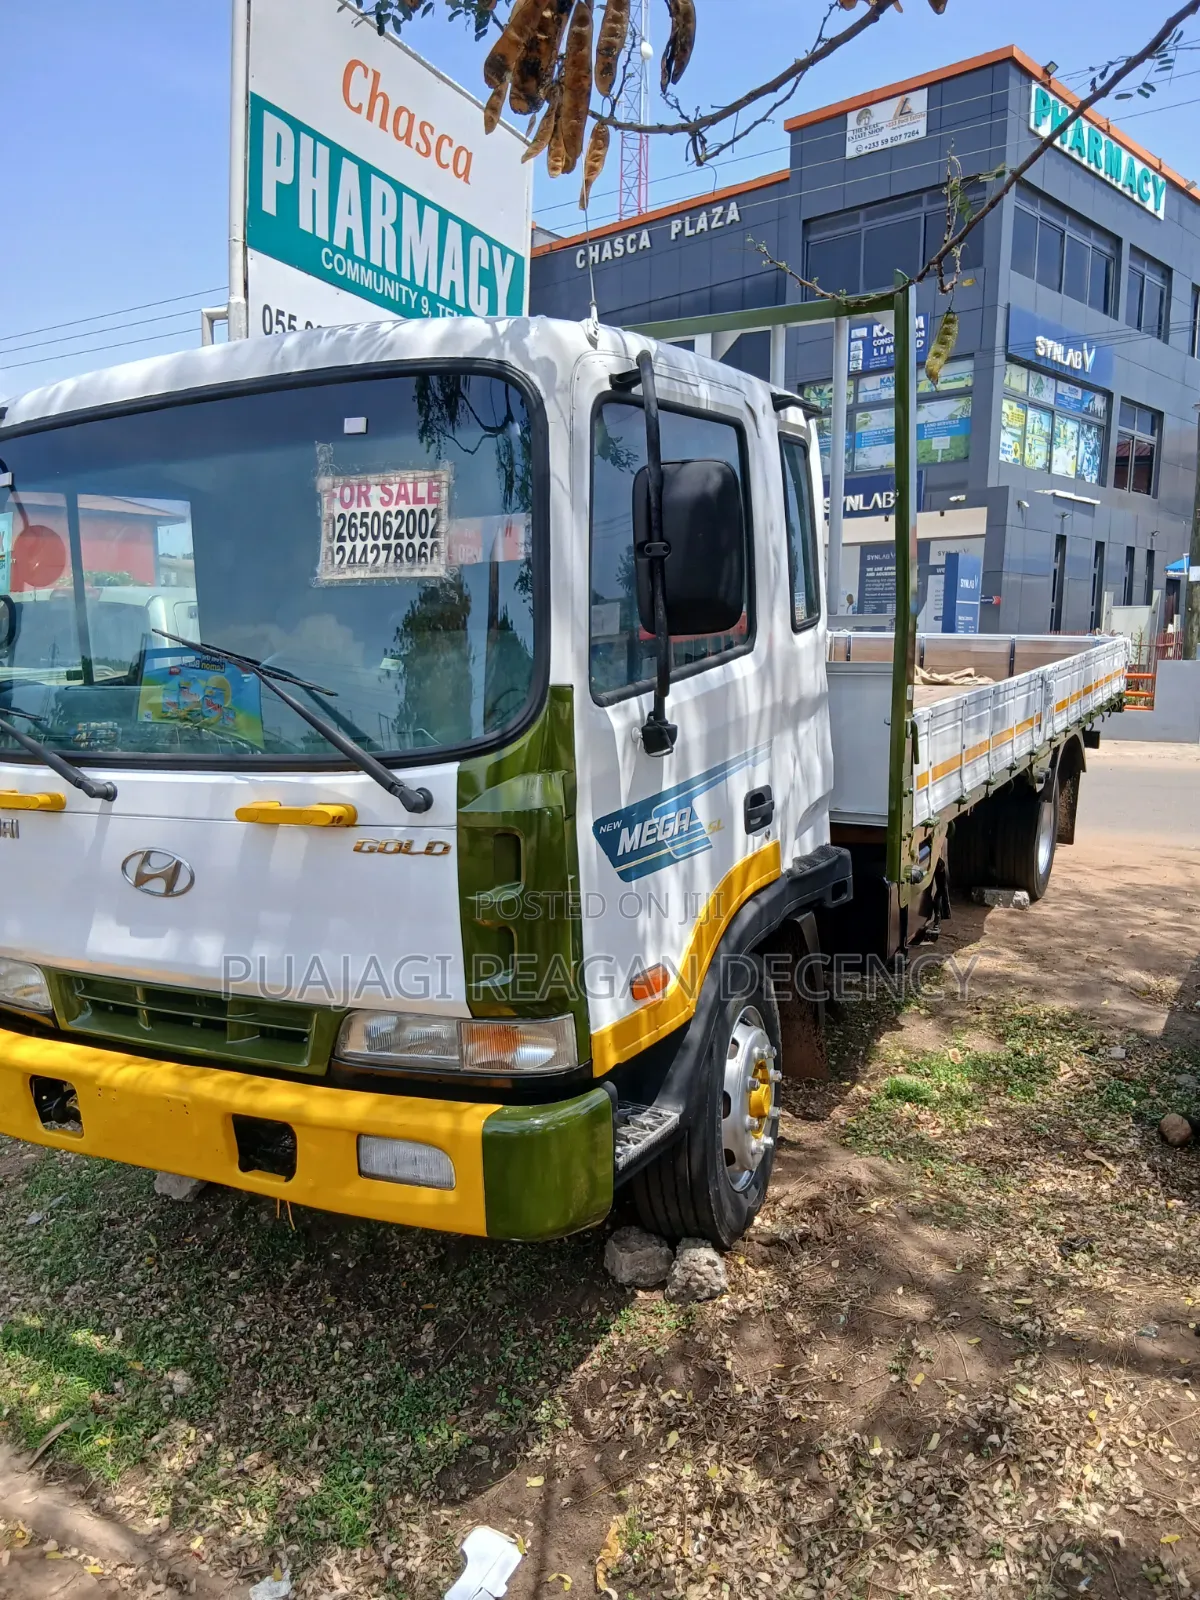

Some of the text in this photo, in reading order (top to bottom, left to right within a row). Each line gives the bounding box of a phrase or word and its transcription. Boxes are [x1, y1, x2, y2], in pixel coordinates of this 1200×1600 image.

[341, 58, 474, 185] Chasca
[868, 126, 885, 136] SHOP
[864, 129, 920, 151] +233 59 507 7264
[1034, 87, 1166, 212] PHARMACY
[262, 110, 515, 317] PHARMACY
[576, 201, 742, 269] CHASCA PLAZA
[321, 250, 419, 309] COMMUNITY
[421, 296, 432, 317] 9,
[1036, 336, 1082, 369] SYNLAB
[327, 476, 442, 509] FOR SALE
[824, 492, 895, 513] SNLAB
[599, 819, 623, 834] NEW
[616, 807, 692, 856] MEGA
[353, 838, 452, 856] GOLD
